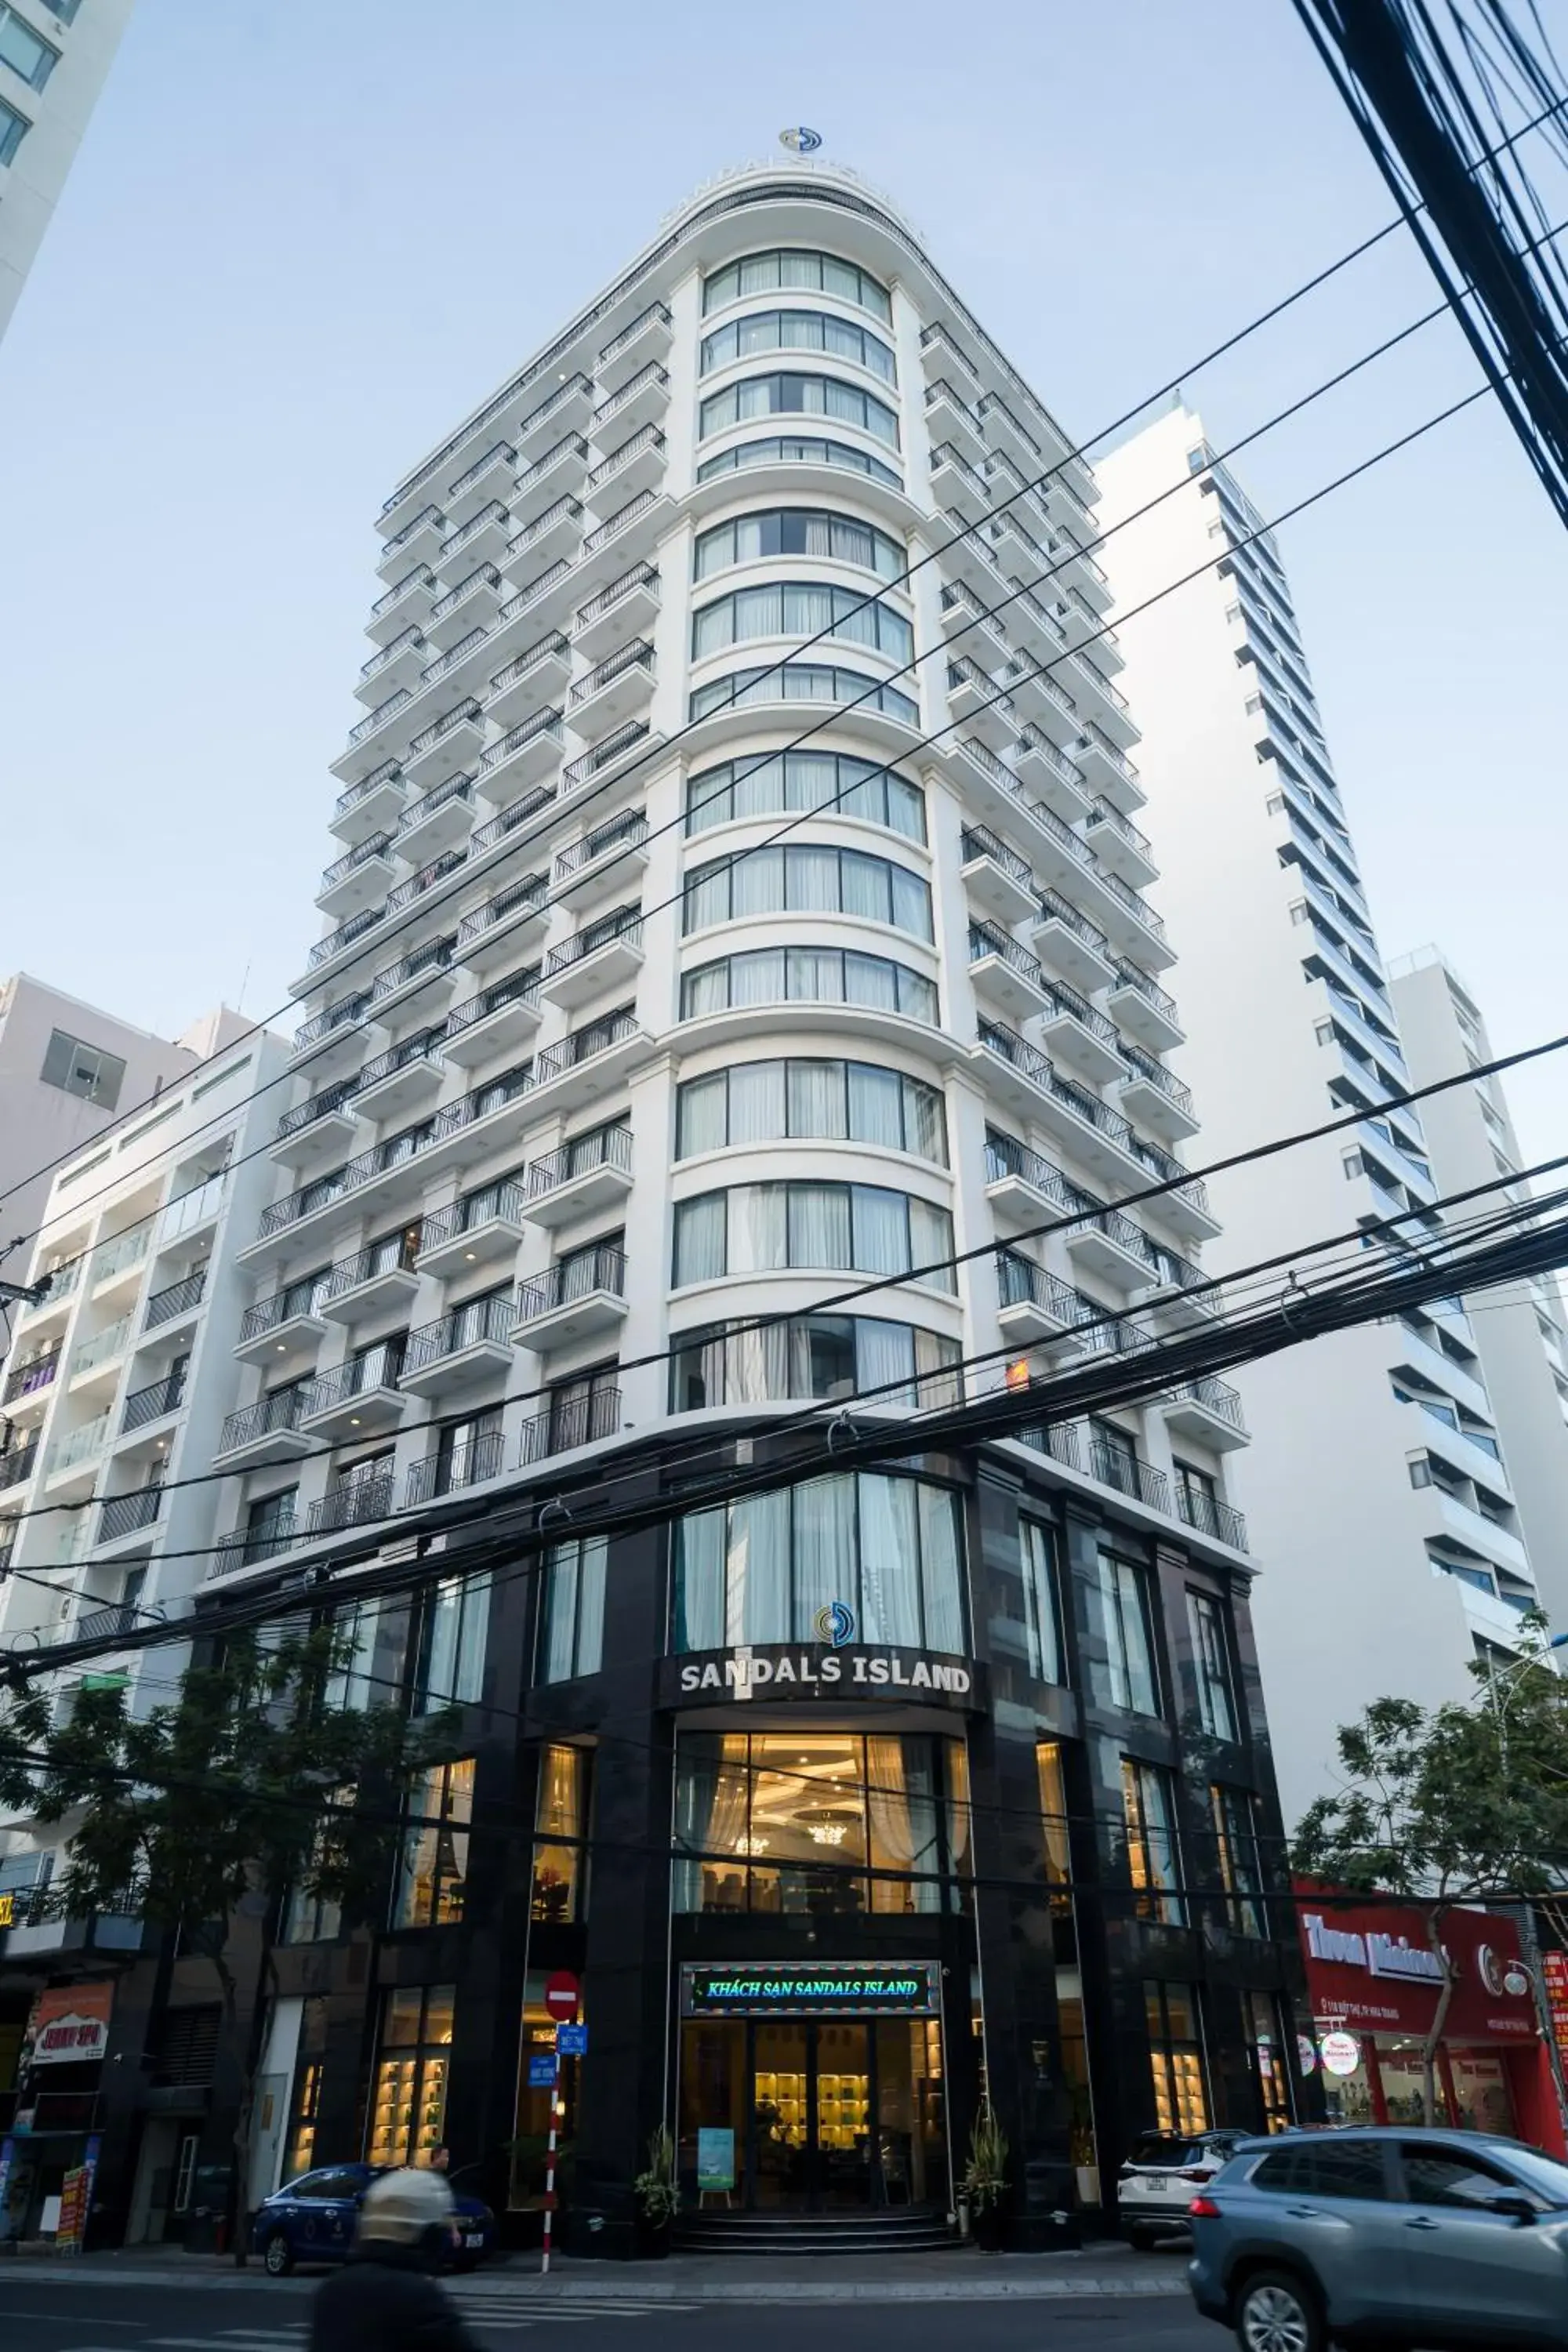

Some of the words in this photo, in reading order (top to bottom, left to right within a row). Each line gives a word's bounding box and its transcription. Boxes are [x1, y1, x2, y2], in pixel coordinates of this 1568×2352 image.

[681, 1657, 841, 1691] SANDALS
[853, 1657, 970, 1693] ISLAND
[706, 1978, 760, 1997] KHÁCH
[763, 1981, 793, 1998] SẠN
[794, 1980, 861, 1996] SANDALS
[862, 1980, 918, 1996] ISLAND
